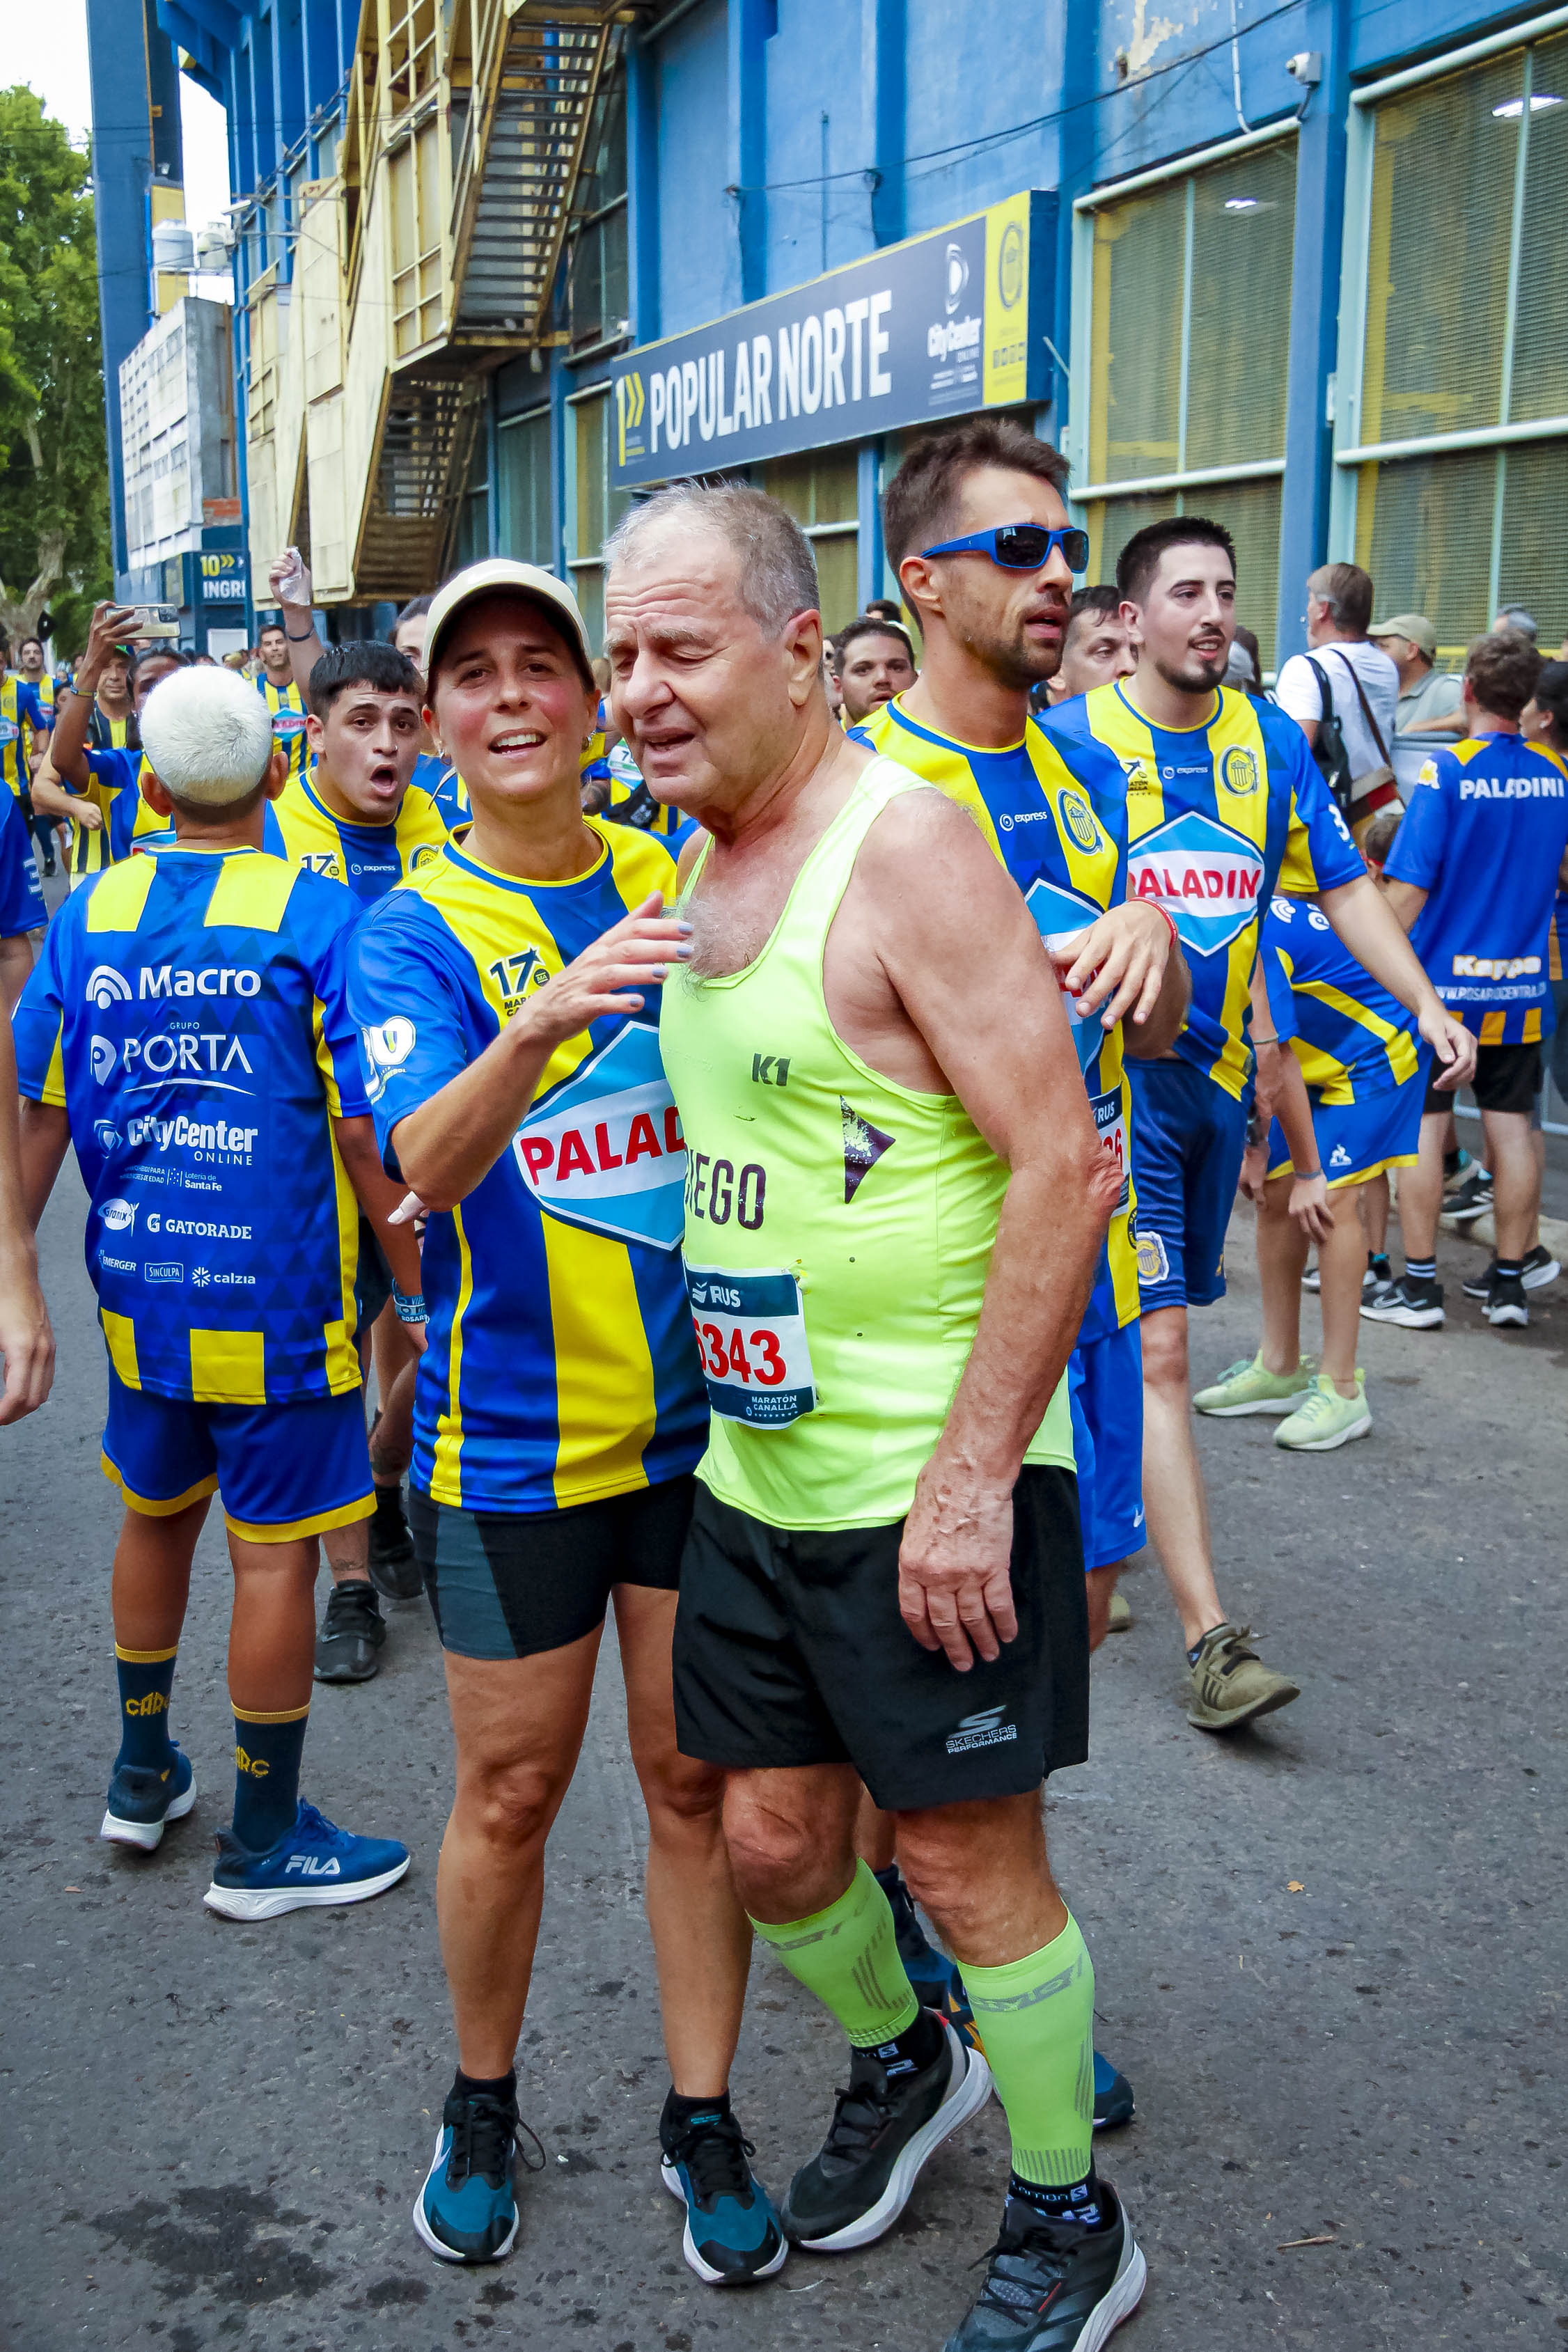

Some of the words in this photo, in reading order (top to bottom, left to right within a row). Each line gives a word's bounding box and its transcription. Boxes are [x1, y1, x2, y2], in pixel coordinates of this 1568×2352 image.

[650, 334, 771, 455] POPULAR
[778, 290, 892, 421] NORTE
[1459, 776, 1565, 800] PALADINI
[1014, 811, 1047, 824] express
[489, 948, 541, 996] 17
[1453, 955, 1542, 980] Kappa
[139, 965, 261, 1000] Macro
[170, 1021, 200, 1030] GRUPO
[123, 1034, 253, 1074] PORTA
[752, 1053, 791, 1087] K1
[1097, 1101, 1115, 1123] RUS
[127, 1115, 258, 1152] CityCenter
[194, 1151, 252, 1166] ONLINE
[148, 1175, 164, 1184] EDAD
[185, 1179, 211, 1190] Santa
[212, 1183, 222, 1191] Fe
[207, 1173, 217, 1181] de
[104, 1207, 127, 1221] Granix
[165, 1218, 252, 1239] GATORADE
[709, 1285, 741, 1308] RUS
[752, 1394, 797, 1404] MARATÓN
[753, 1402, 797, 1411] CANALLA
[946, 1724, 1017, 1749] SKECHERS
[948, 1732, 1017, 1754] PERFORMANCE
[285, 1855, 340, 1874] FILA
